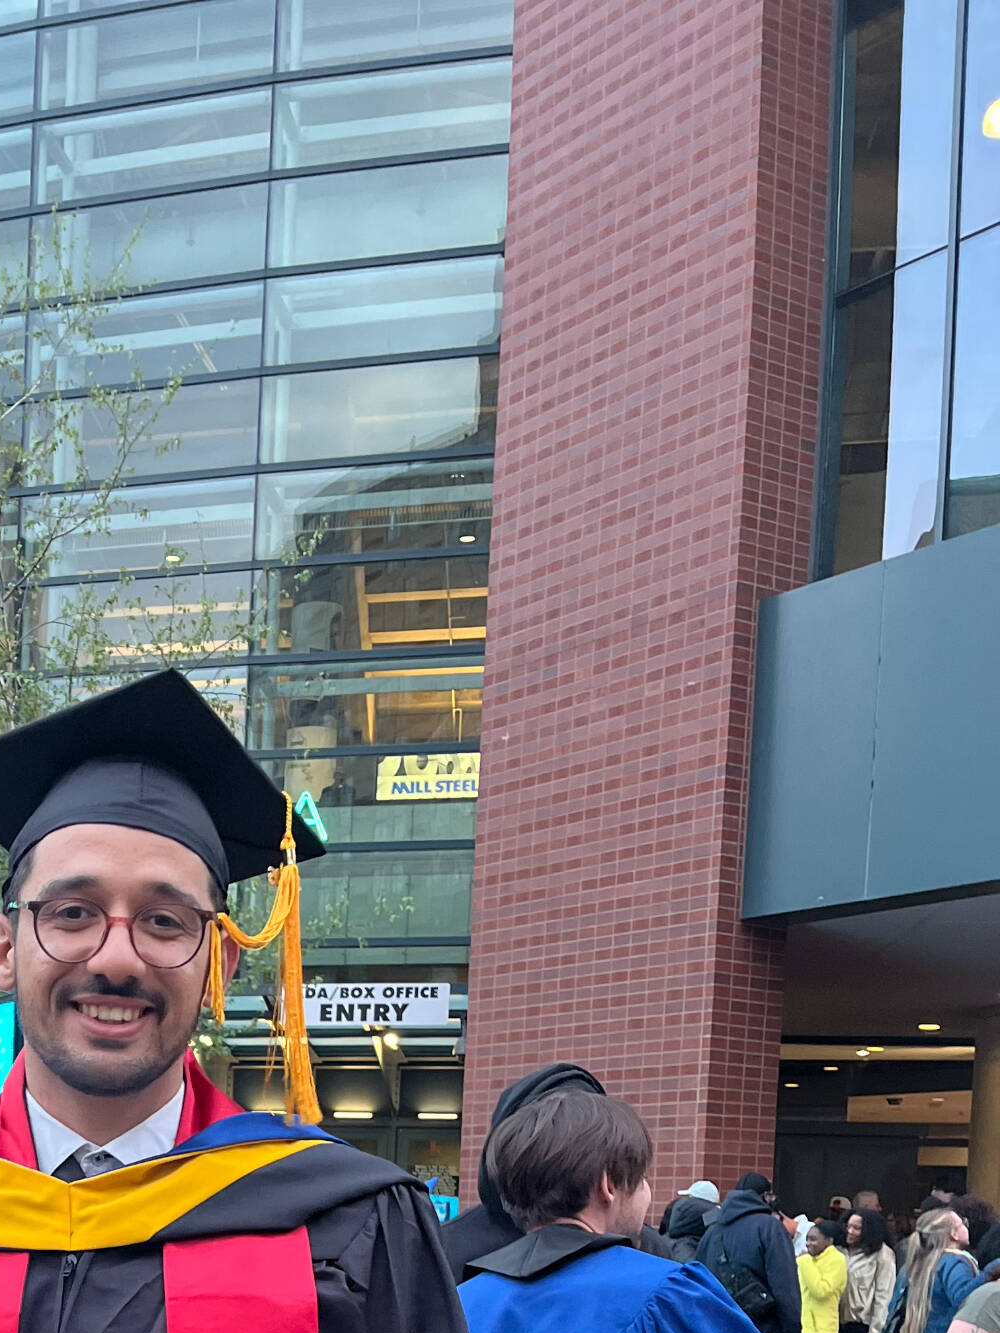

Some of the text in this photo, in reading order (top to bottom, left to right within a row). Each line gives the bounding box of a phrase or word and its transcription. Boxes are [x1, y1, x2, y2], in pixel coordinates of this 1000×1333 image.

[391, 779, 479, 795] MILL STEEL
[304, 986, 439, 1000] DA/BOX OFFICE
[319, 1003, 410, 1022] ENTRY
